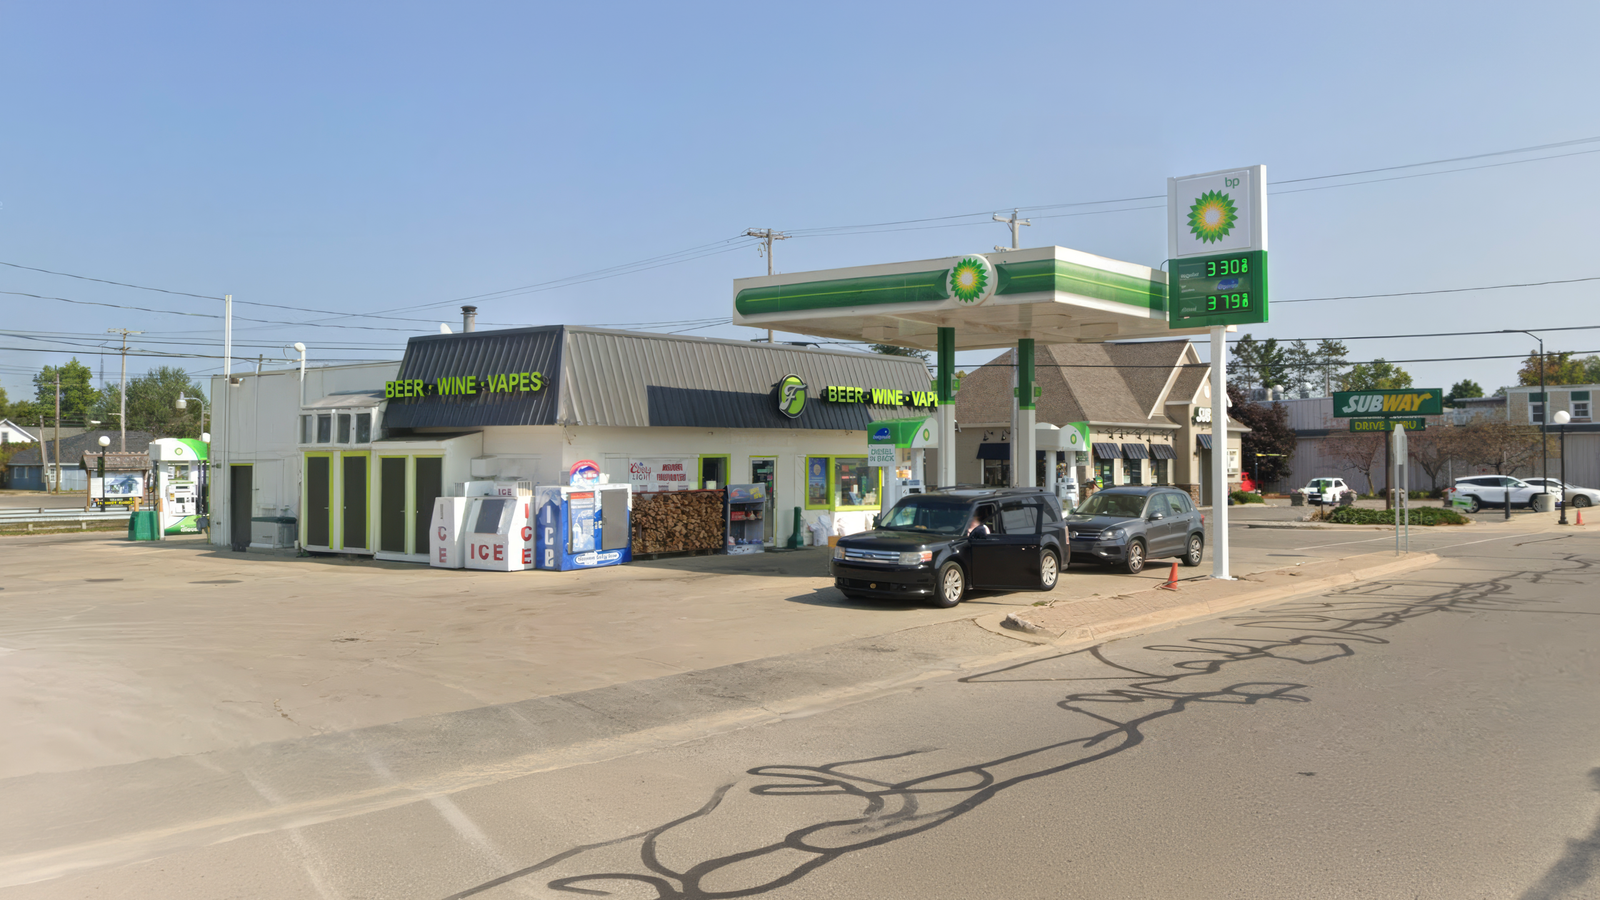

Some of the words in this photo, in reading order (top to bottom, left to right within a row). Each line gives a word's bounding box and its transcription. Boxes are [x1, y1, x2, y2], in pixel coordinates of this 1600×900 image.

[1225, 177, 1240, 189] bp
[385, 379, 425, 398] BEER
[437, 376, 477, 395] WINE
[488, 372, 542, 393] VAPES
[828, 386, 864, 403] BEER
[871, 388, 904, 406] WINE
[911, 390, 939, 407] VAP
[1342, 393, 1433, 413] SUBWAY
[1355, 420, 1385, 431] DRIVE
[498, 488, 512, 496] ICE
[438, 503, 447, 563] ICE
[521, 503, 532, 564] ICE
[470, 543, 504, 561] ICE
